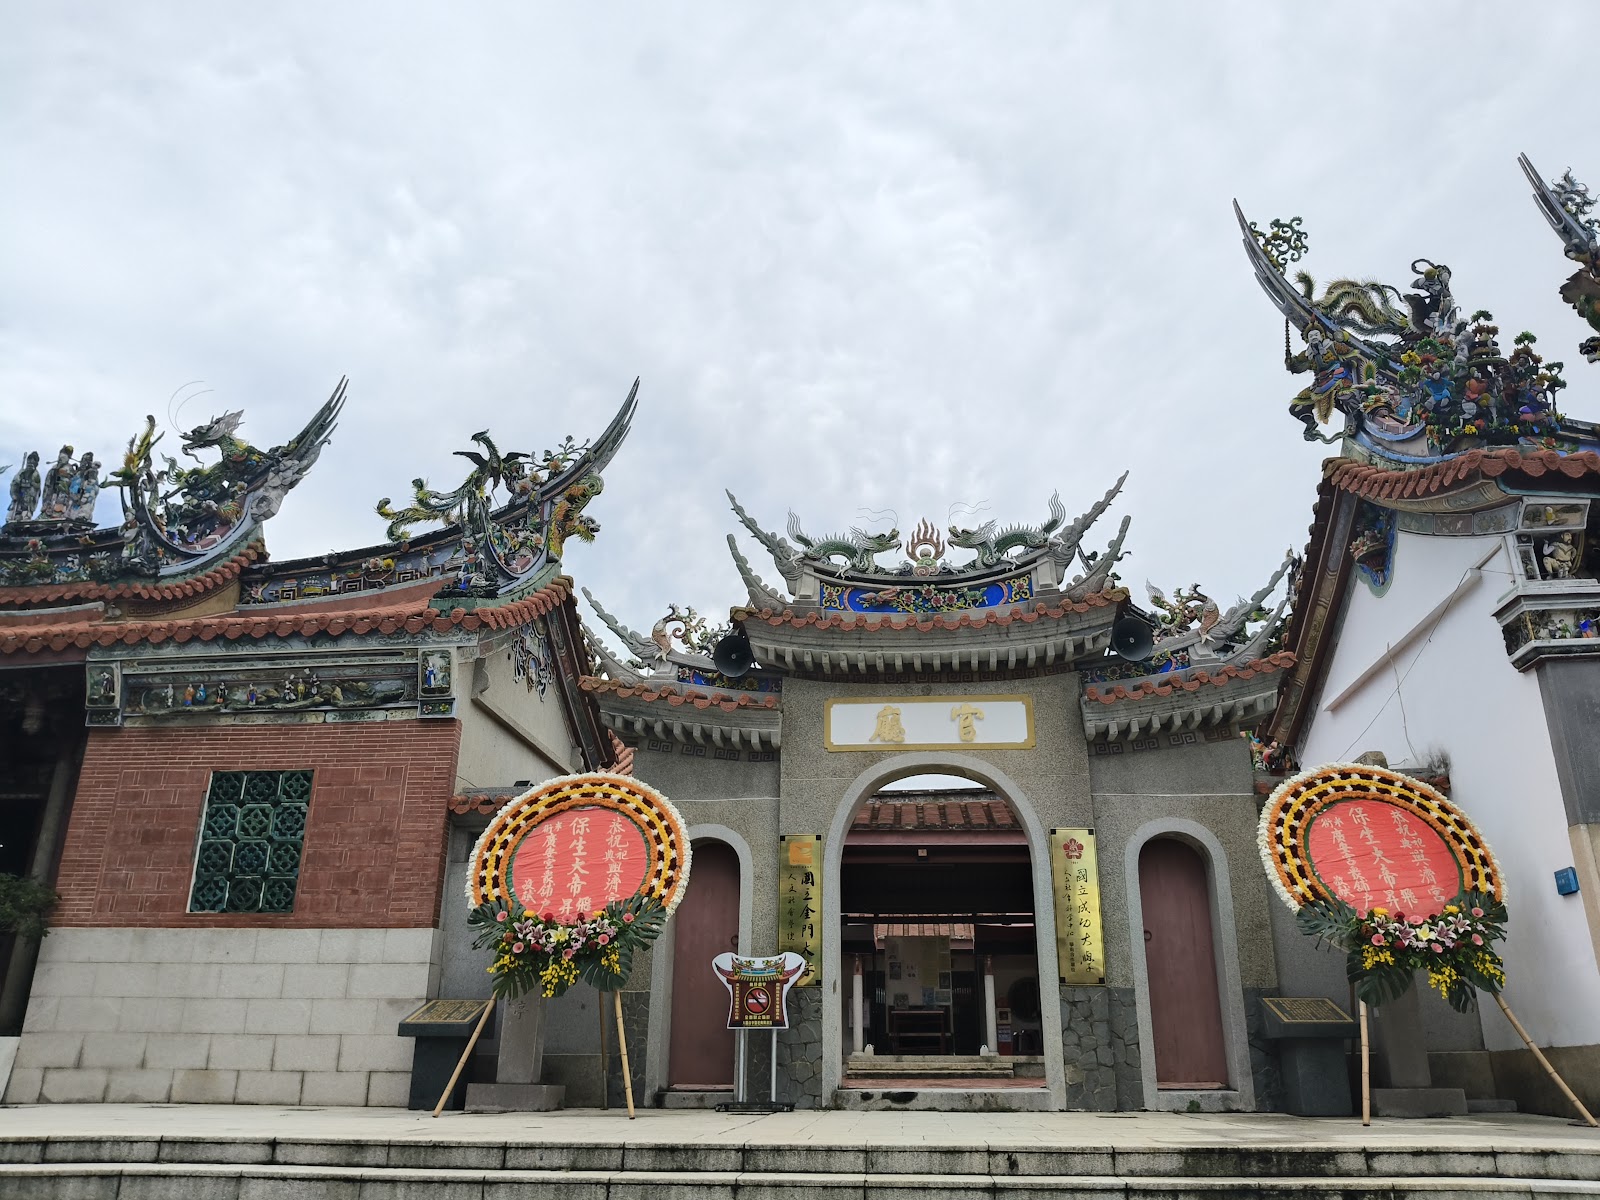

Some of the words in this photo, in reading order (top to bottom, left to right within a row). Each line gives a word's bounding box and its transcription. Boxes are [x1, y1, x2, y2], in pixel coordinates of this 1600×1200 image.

[567, 816, 590, 897] 保生大帝
[1349, 807, 1399, 889] 保生大帝
